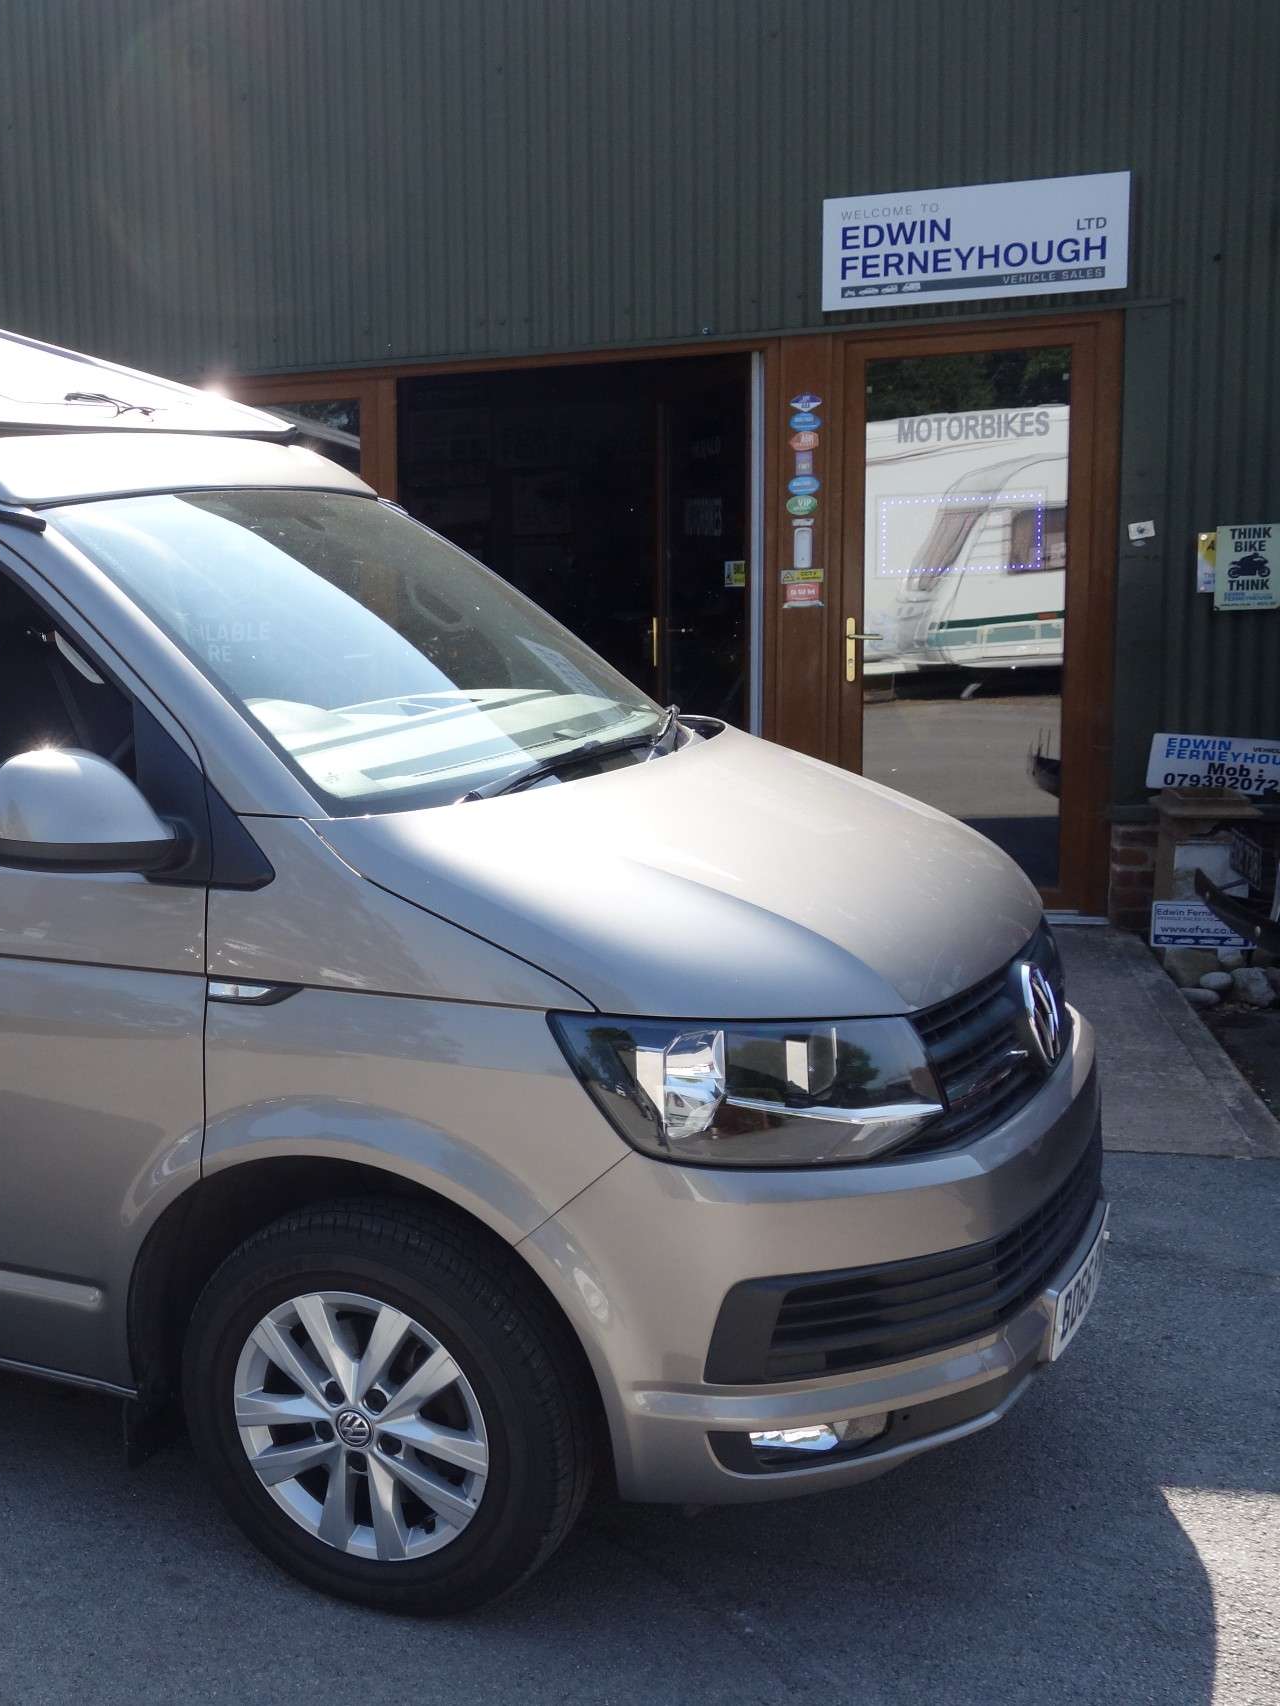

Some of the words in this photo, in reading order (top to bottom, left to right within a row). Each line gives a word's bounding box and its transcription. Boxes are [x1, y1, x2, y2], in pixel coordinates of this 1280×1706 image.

[841, 205, 913, 221] WELCOME
[921, 203, 940, 214] TO
[1076, 217, 1107, 231] LTD
[841, 218, 952, 251] EDWIN
[840, 235, 1107, 281] FERNEYHOUGH
[1002, 271, 1057, 285] VEHICLE
[1062, 268, 1104, 281] SALES
[897, 411, 1051, 444] MOTORBIKES
[1229, 527, 1272, 540] THINK
[1234, 540, 1267, 552] BIKE
[1228, 579, 1270, 591] THINK
[1166, 738, 1232, 751] EDWIN
